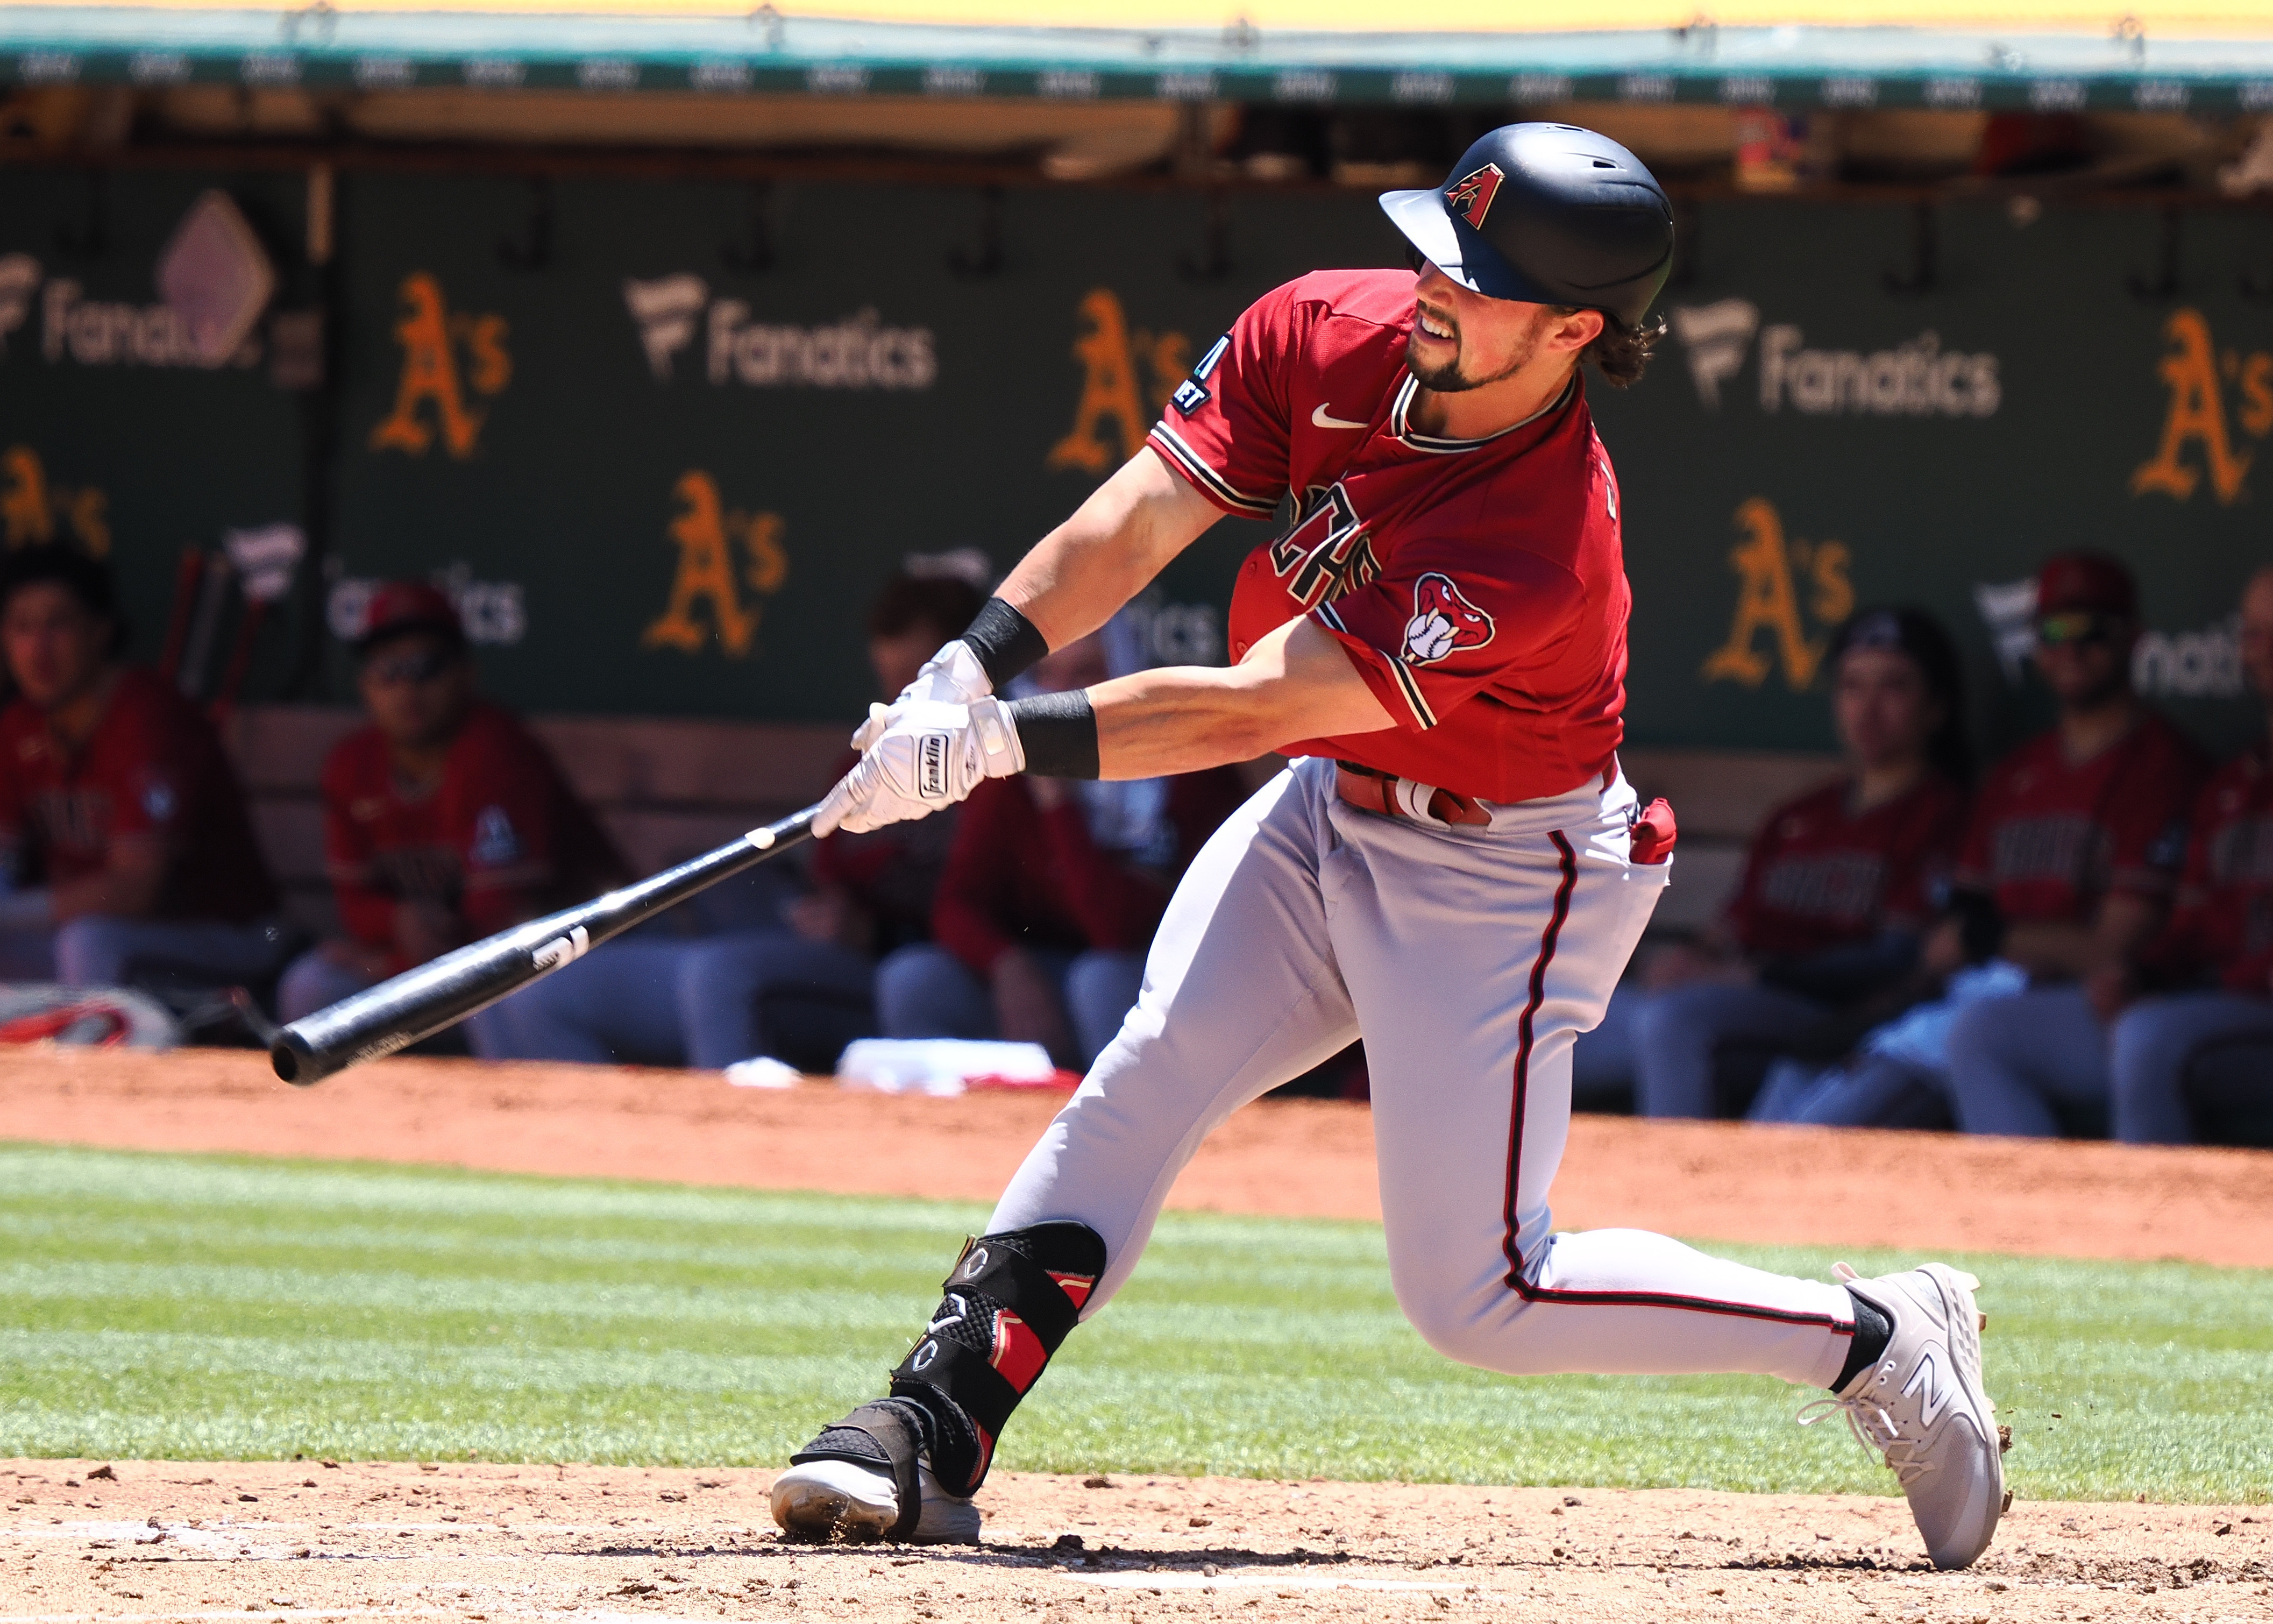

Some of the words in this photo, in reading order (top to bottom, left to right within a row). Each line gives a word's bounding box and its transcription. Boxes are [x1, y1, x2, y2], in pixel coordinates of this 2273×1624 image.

[372, 272, 514, 459] A's
[705, 299, 938, 389] Fanatics
[1758, 323, 2002, 419] Fanatics
[645, 469, 789, 657] A's
[1703, 497, 1855, 689] A's
